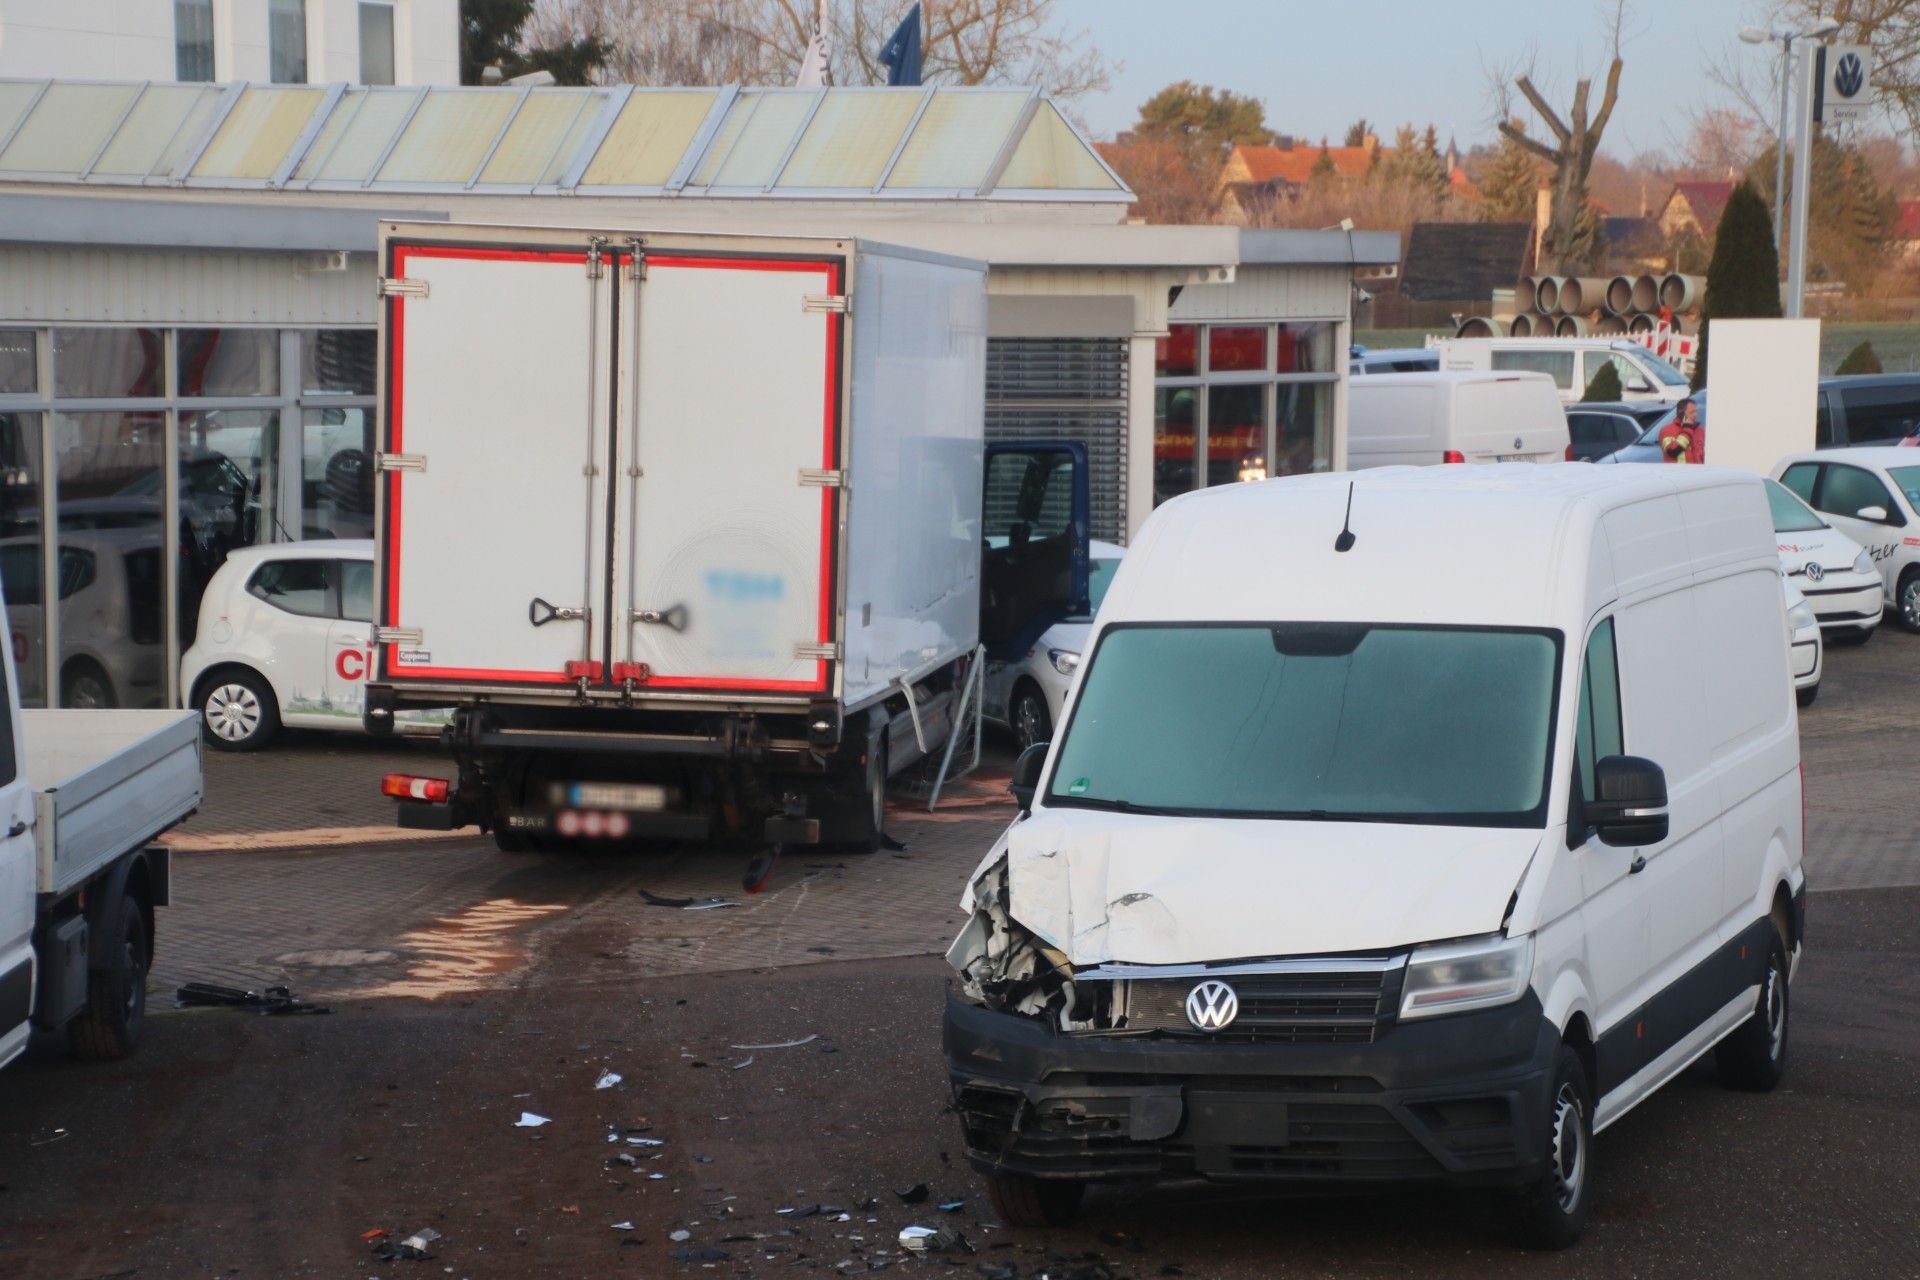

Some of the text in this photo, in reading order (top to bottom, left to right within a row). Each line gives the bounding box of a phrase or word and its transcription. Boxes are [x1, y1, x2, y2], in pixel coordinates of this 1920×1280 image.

[1835, 52, 1863, 98] VW
[1865, 543, 1899, 562] tzer
[1186, 981, 1238, 1030] VW
